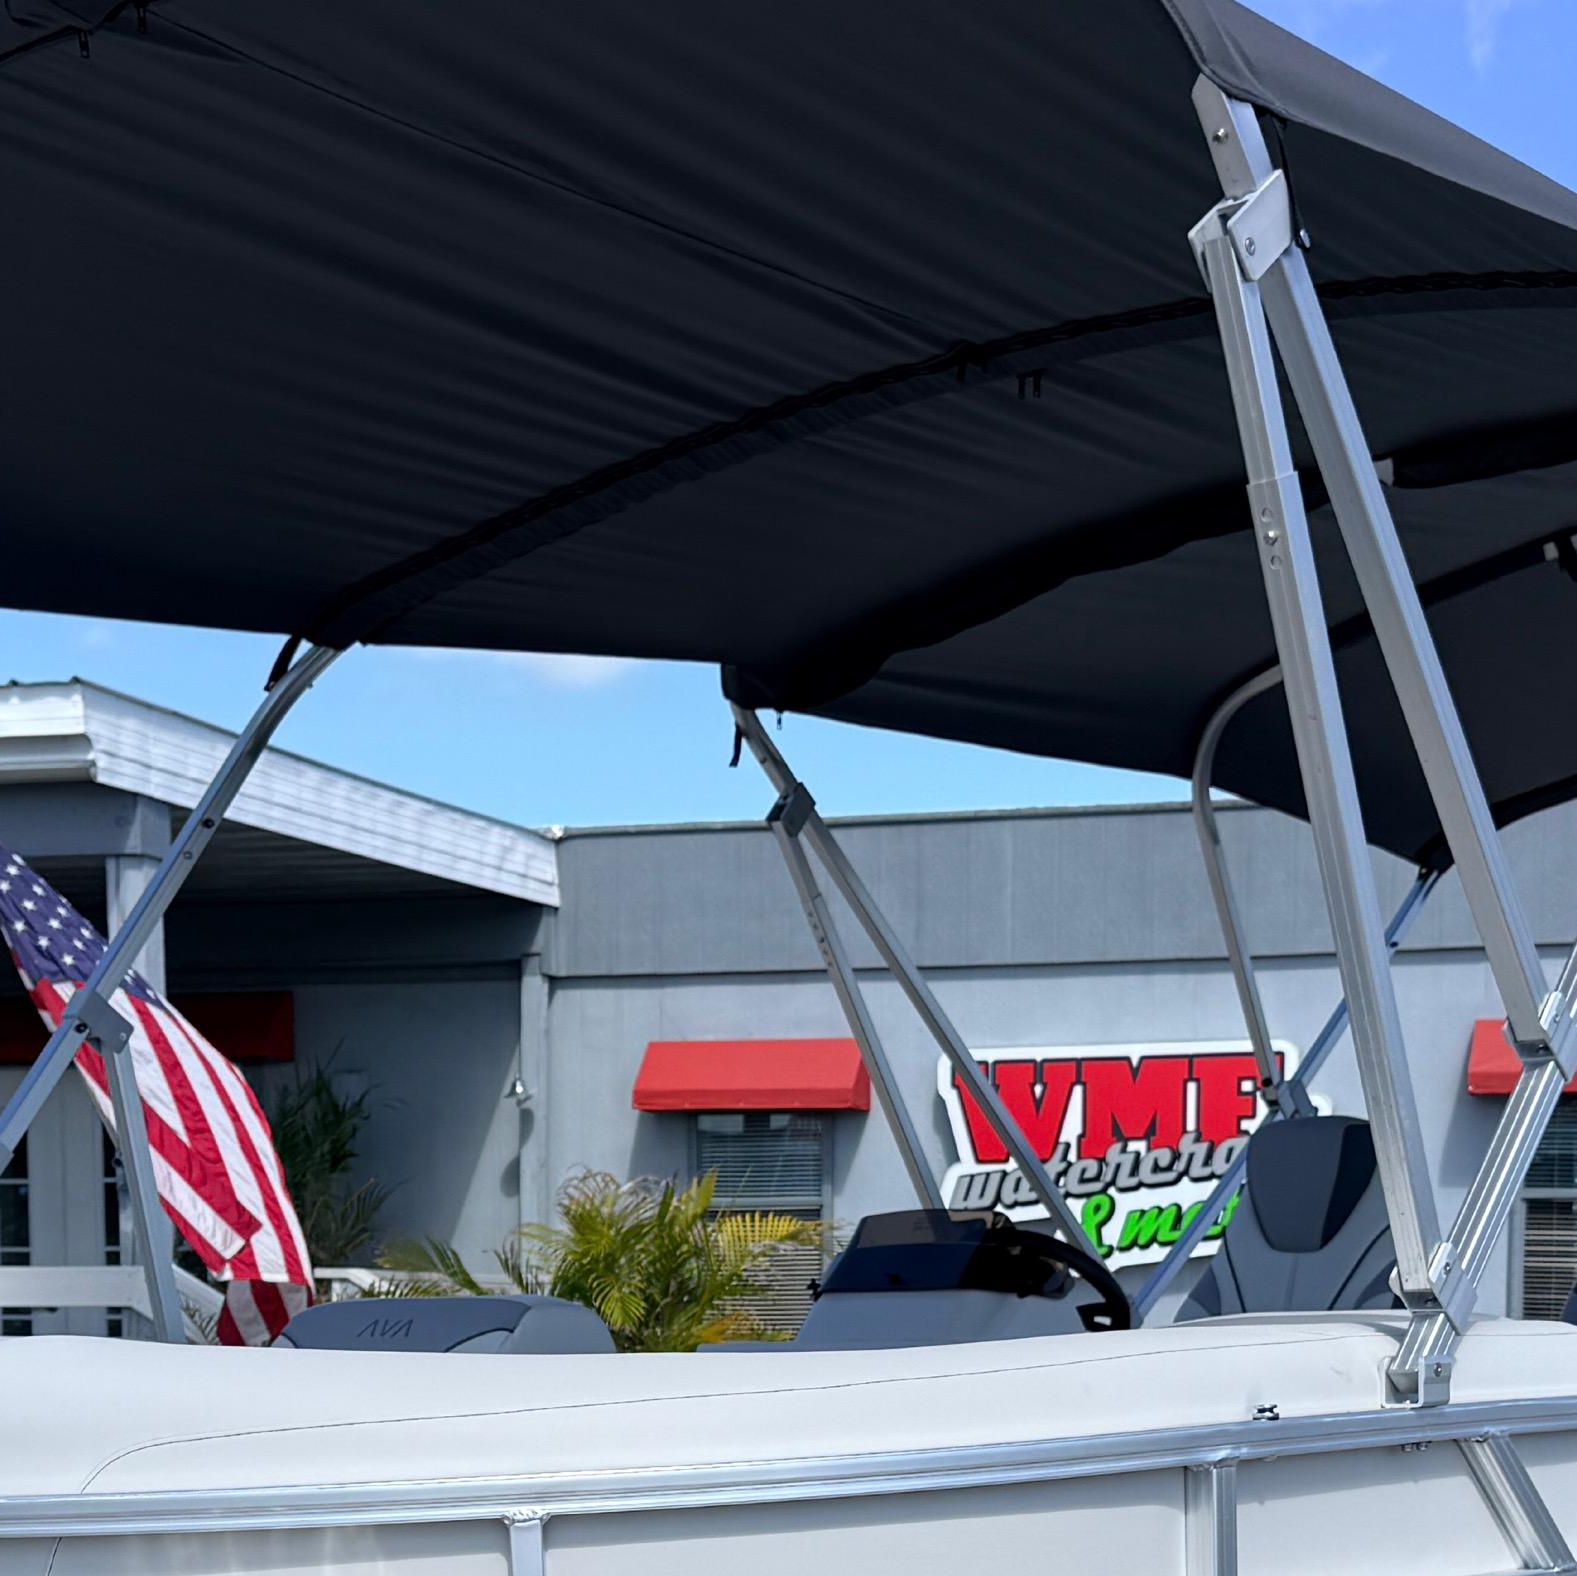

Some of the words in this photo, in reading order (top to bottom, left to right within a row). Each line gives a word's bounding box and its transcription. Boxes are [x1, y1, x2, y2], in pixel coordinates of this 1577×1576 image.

[952, 1052, 1285, 1163] WMF
[949, 1131, 1252, 1211] watercra
[355, 1318, 414, 1338] AVA
